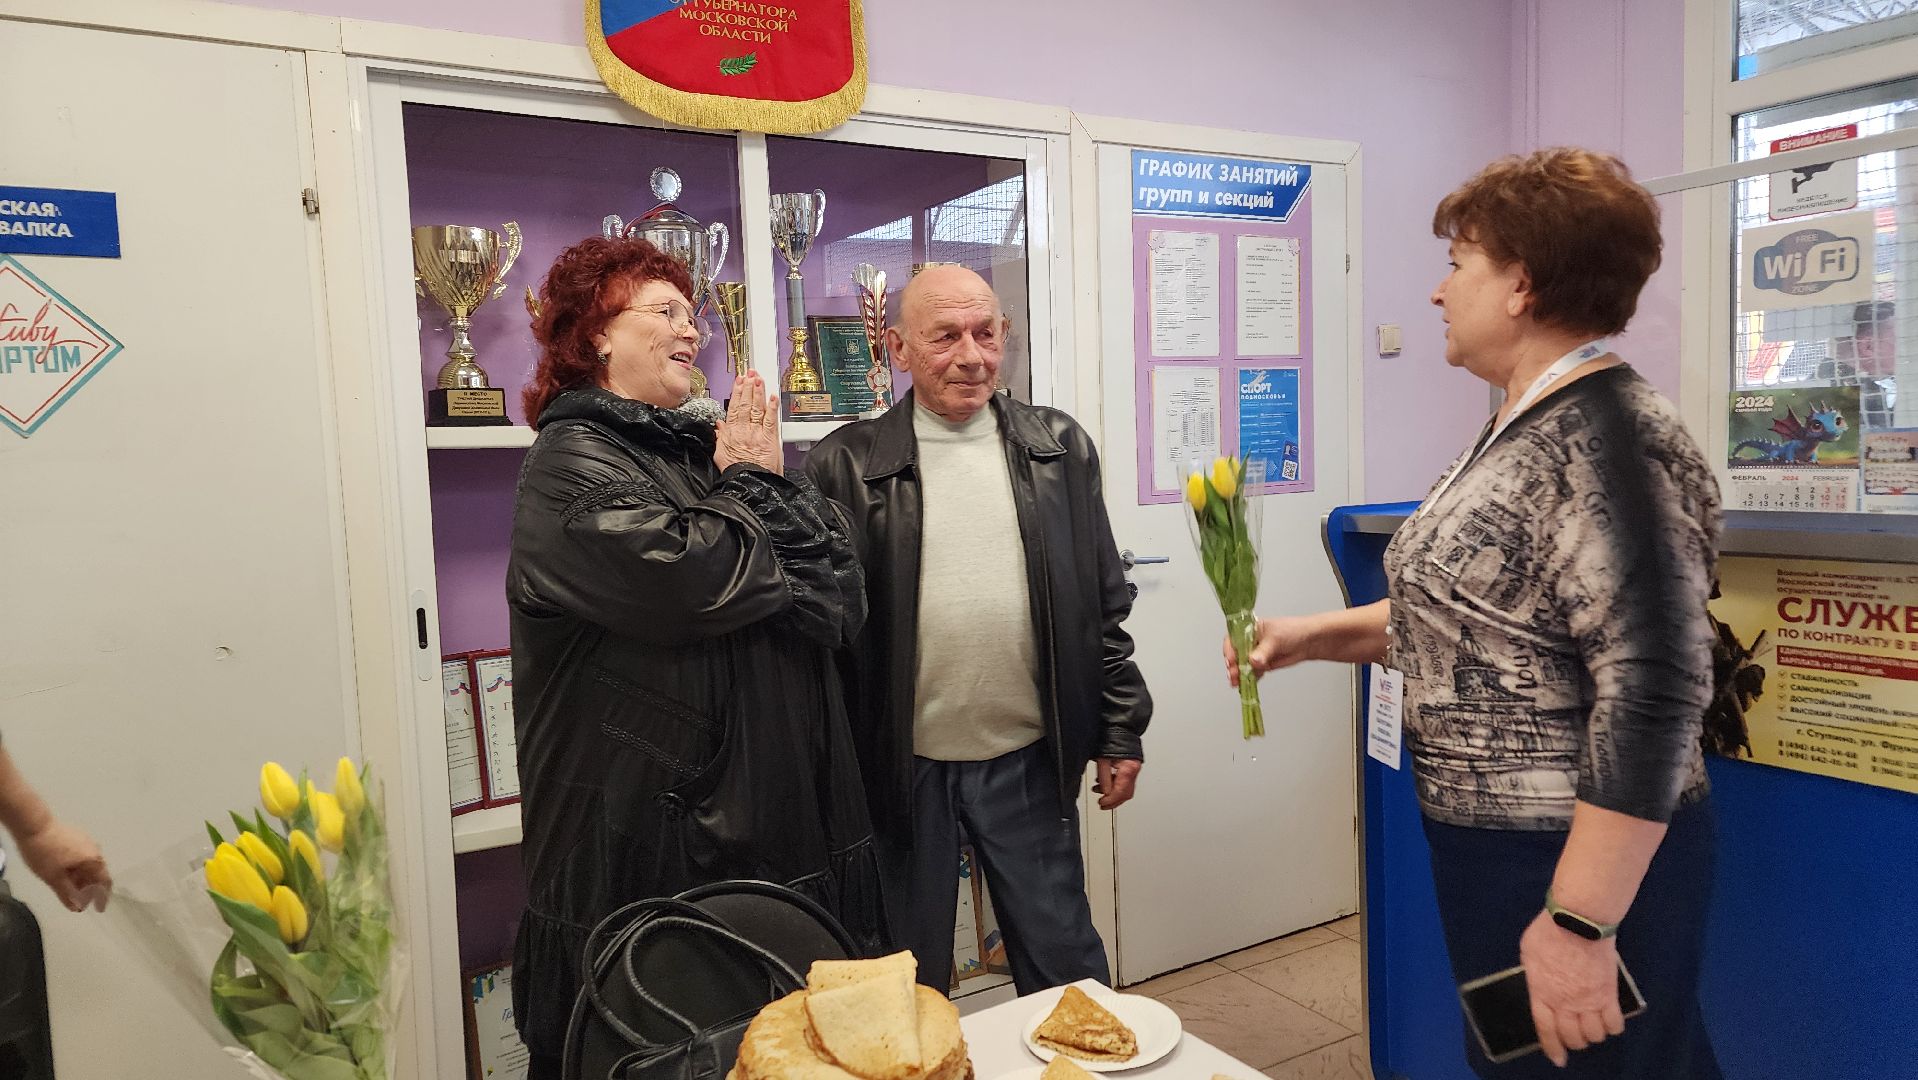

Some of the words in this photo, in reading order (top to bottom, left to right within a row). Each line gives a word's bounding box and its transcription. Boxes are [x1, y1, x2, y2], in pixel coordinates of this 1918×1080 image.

[679, 7, 789, 33] МОСКОВСКОЙ
[699, 24, 772, 44] ОБЛАСТИ
[1778, 128, 1849, 151] ВНИМАНИЕ
[1139, 158, 1215, 181] ГРАФИК
[1218, 164, 1299, 187] ЗАНЯТИЙ
[0, 199, 56, 217] СКАЯ
[1139, 187, 1193, 208] групп
[1198, 192, 1209, 204] и
[1214, 192, 1274, 209] секций
[0, 221, 74, 238] ВАЛКА
[1763, 252, 1802, 280] Wi
[1820, 247, 1846, 274] Fi
[1240, 383, 1273, 394] СПОРТ
[1735, 396, 1774, 408] 2024
[1776, 577, 1835, 587] Московской
[1778, 627, 1799, 639] ПО
[1803, 631, 1891, 649] КОНТРАКТУ
[1790, 673, 1859, 687] СТАБИЛЬНОСТЬ
